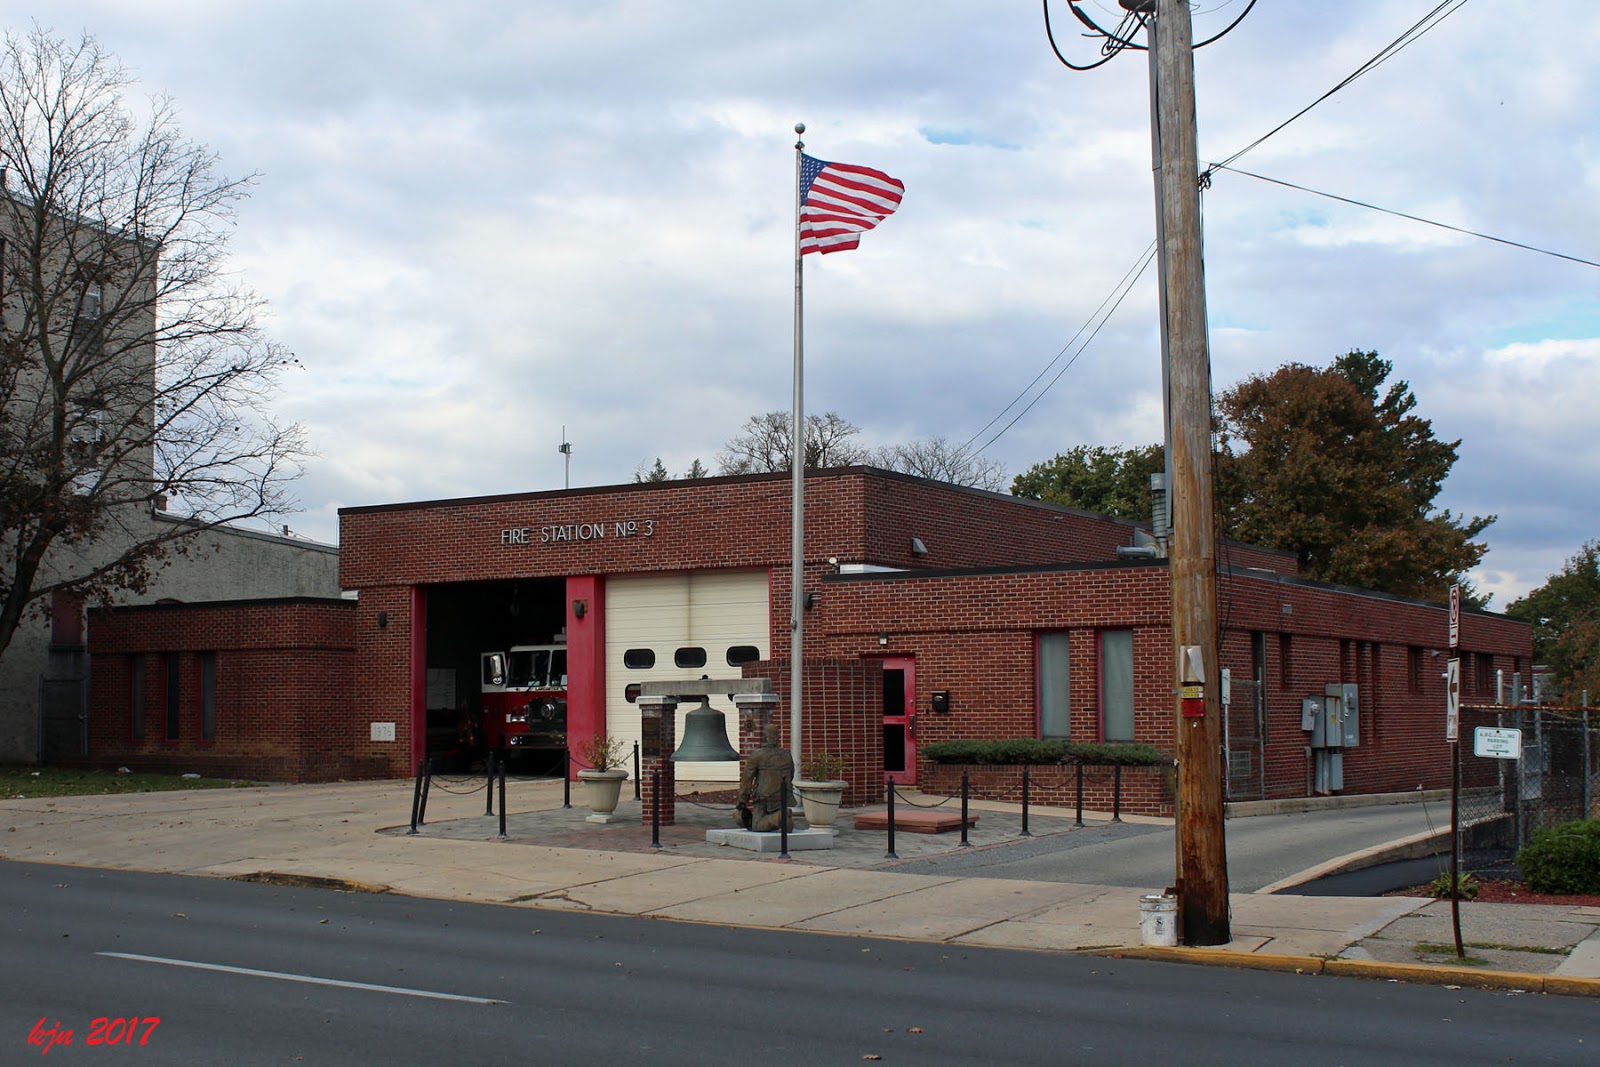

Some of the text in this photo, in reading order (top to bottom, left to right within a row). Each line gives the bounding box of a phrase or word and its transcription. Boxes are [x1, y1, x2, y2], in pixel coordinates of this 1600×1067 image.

[501, 528, 530, 544] FIRE
[541, 523, 604, 543] STATION
[644, 519, 653, 536] 3
